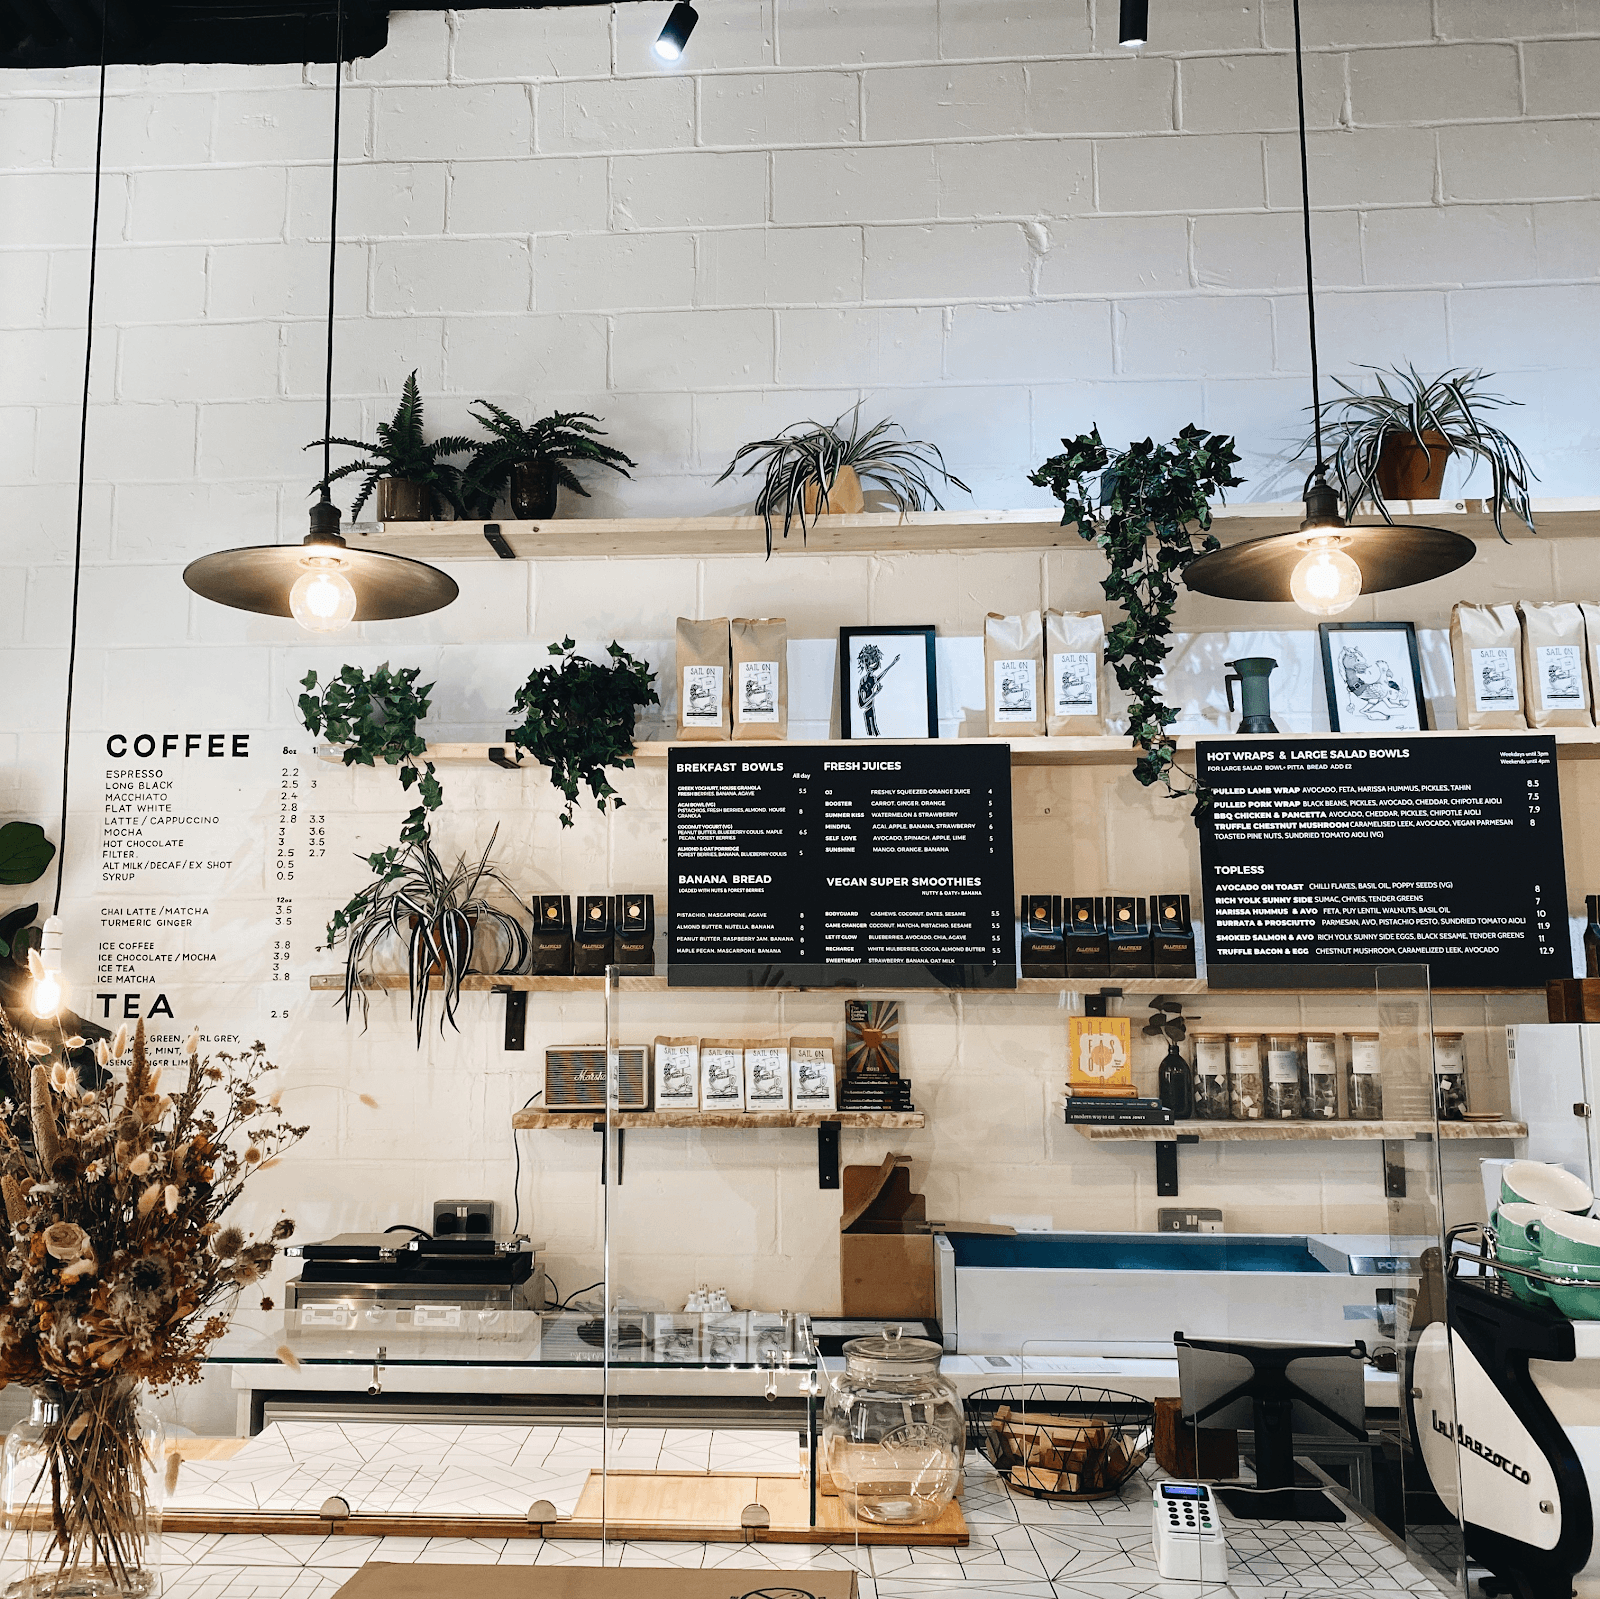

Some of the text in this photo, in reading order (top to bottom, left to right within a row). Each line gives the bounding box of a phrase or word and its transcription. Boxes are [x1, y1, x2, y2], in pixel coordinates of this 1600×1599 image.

[107, 734, 250, 757] COFFEE
[1207, 749, 1409, 761] HOT WRAPS & LARGE SALAD BOWLS
[677, 763, 784, 772] BREKFAST BOWLS
[824, 762, 901, 771] FRESH JUICES
[106, 768, 299, 778] ESPRESSO 2.2
[106, 781, 317, 790] LONG BLACK 2.5 3
[105, 792, 298, 801] MACCHIATO 2.4
[105, 805, 132, 813] FLAT
[137, 804, 171, 812] WHITE
[280, 815, 297, 823] 2.8
[309, 815, 325, 823] 3.3
[1214, 812, 1233, 820] BBQ
[279, 828, 285, 836] 3
[309, 828, 325, 836] 3.6
[103, 838, 325, 848] HOT CHOCOLATE 3 3.5
[278, 849, 294, 857] 2.5
[309, 849, 325, 857] 2.7
[102, 862, 119, 870] ALT
[207, 861, 232, 869] SHOT
[1215, 866, 1264, 875] TOPLESS
[102, 872, 294, 881] SYRUP 0.5
[679, 875, 772, 884] BANANA BREAD
[827, 877, 981, 887] VEGAN SUPER SMOOTHIES
[276, 906, 292, 914] 3.5
[1537, 922, 1550, 930] 11.9
[274, 941, 291, 949] 3.8
[1540, 947, 1554, 955] 12.9
[273, 952, 290, 960] 3.9
[273, 973, 290, 981] 3.8
[96, 994, 174, 1018] TEA
[150, 1035, 184, 1043] GREEN,
[214, 1035, 240, 1044] GREY,
